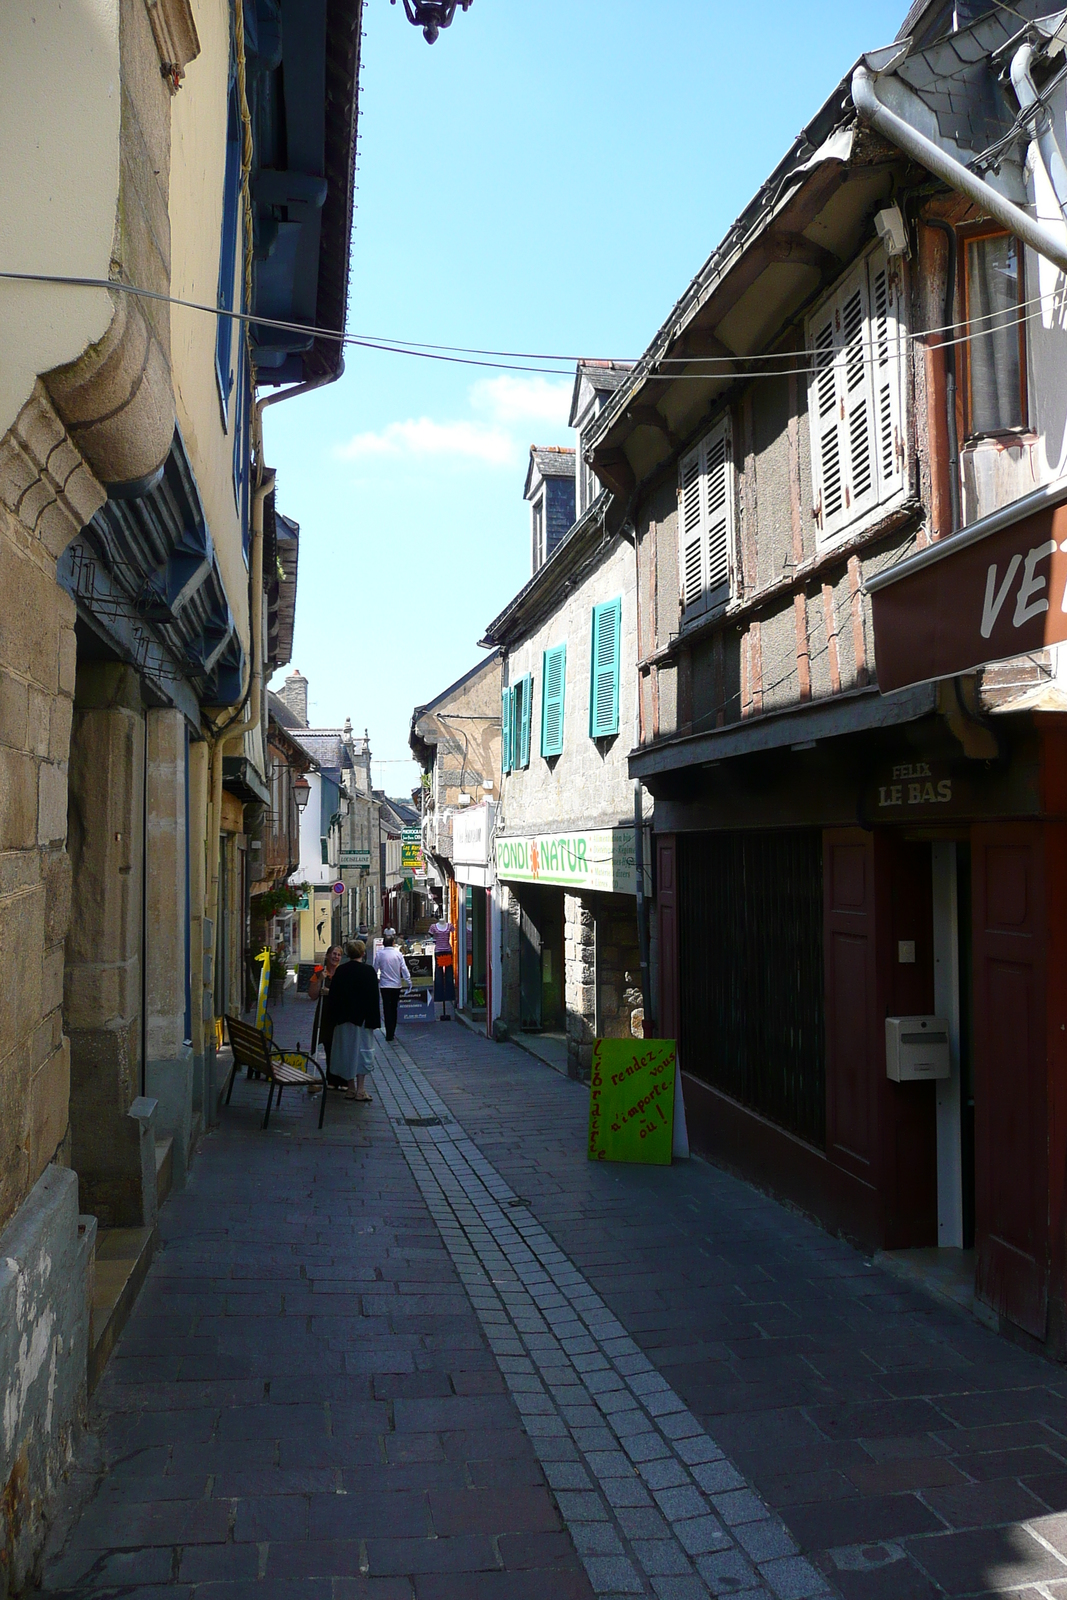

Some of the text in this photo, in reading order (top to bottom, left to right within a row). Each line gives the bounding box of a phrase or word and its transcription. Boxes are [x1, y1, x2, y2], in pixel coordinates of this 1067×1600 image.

[878, 779, 952, 807] LE BAS
[498, 838, 588, 873] PONDI NATUR
[650, 1052, 676, 1077] vous
